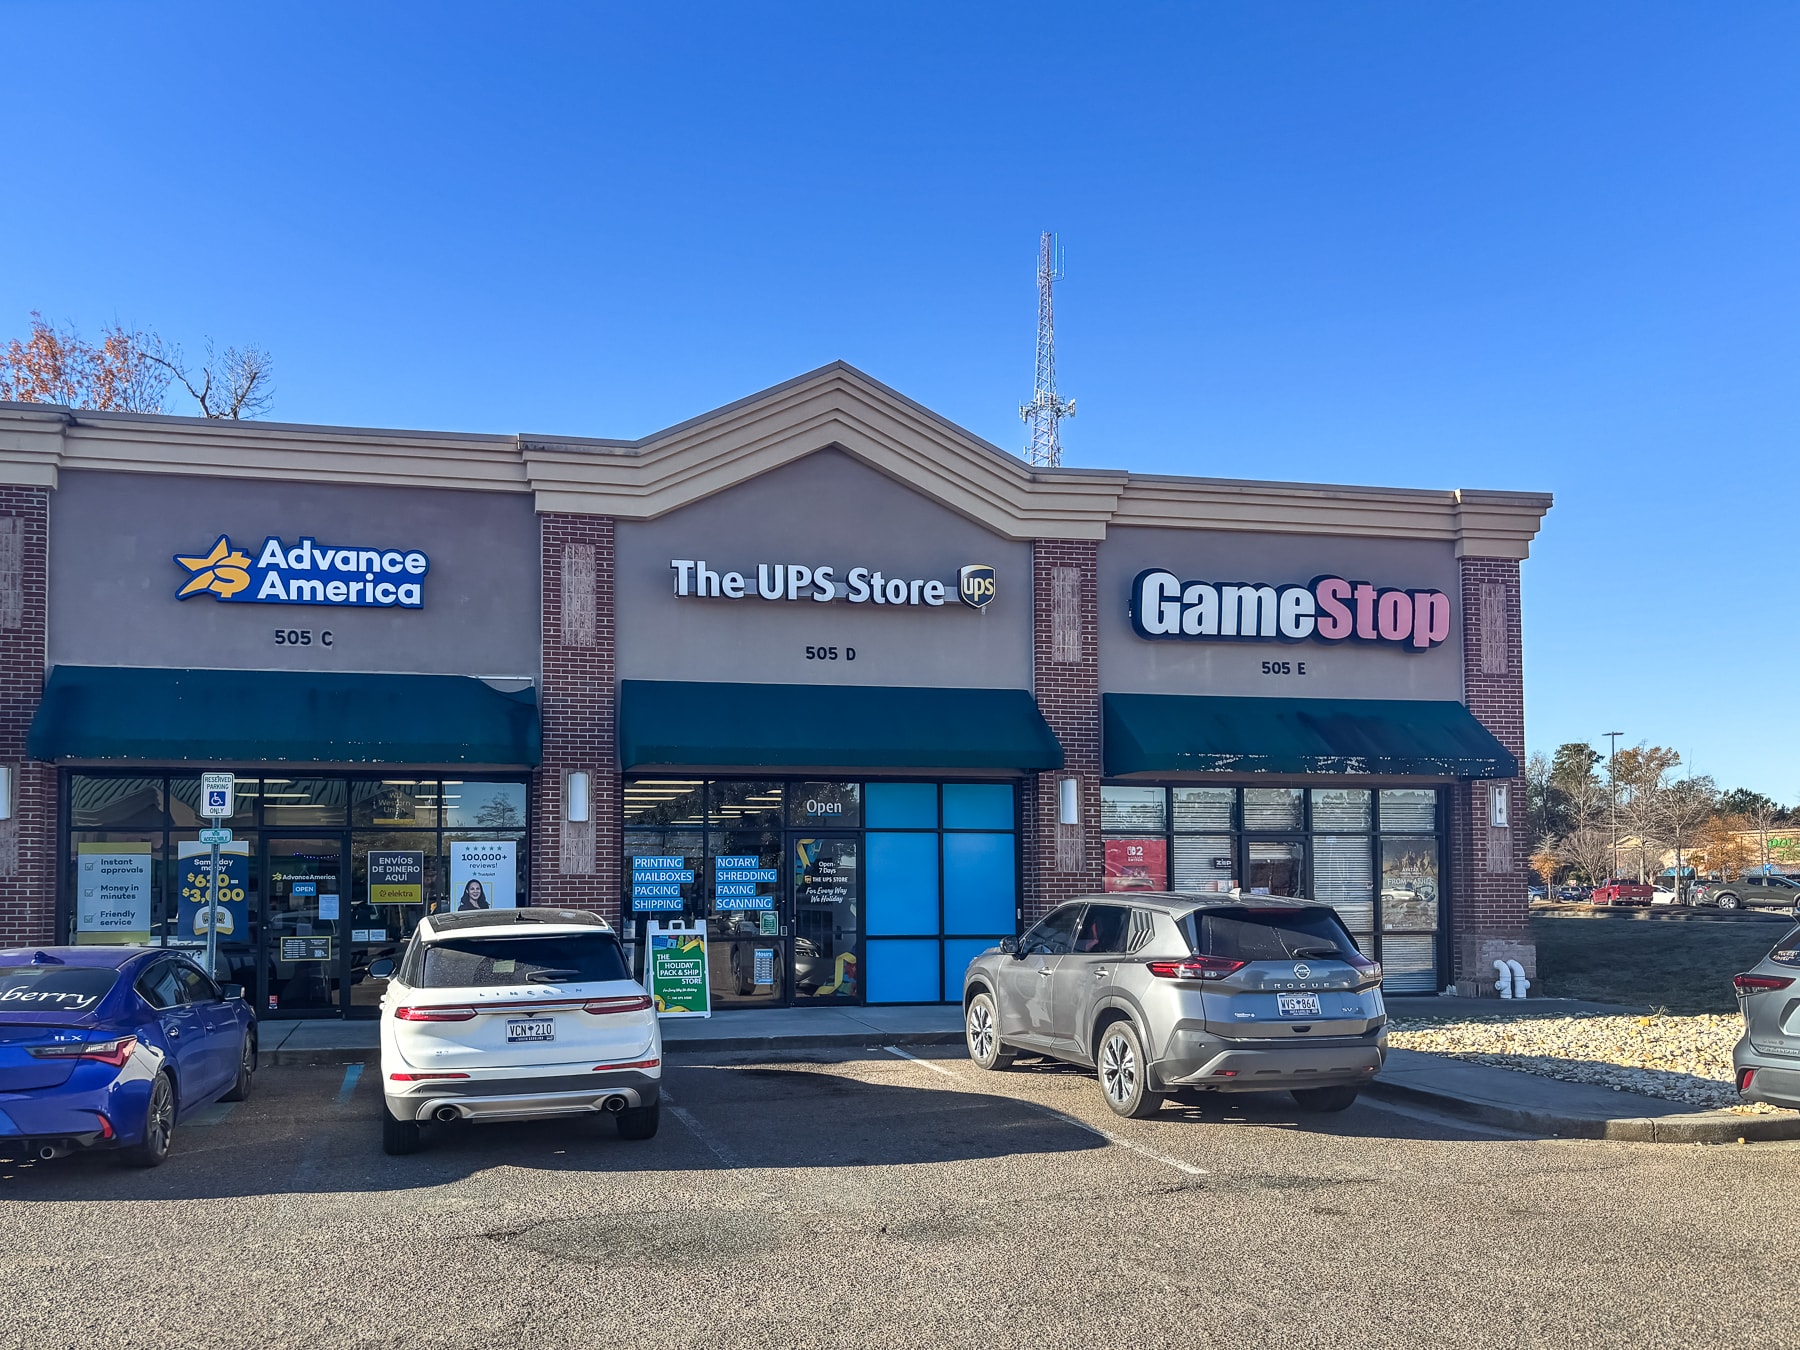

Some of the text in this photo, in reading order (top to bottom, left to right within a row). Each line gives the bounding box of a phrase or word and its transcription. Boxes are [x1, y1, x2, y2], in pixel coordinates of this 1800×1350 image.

[257, 540, 426, 574] Advance
[257, 570, 422, 605] America
[671, 560, 945, 606] The UPS Store
[963, 576, 994, 601] ups
[1140, 571, 1450, 648] GameStop
[274, 629, 333, 646] 505 C
[805, 646, 857, 661] 505 D
[1261, 661, 1306, 676] 505 E
[806, 799, 842, 816] Open
[100, 858, 134, 866] Instant
[379, 855, 414, 865] ENVÍOS
[461, 853, 507, 862] 100,000+
[717, 858, 757, 867] NOTARY
[634, 858, 682, 868] PRINTING
[100, 867, 144, 875] approvals
[201, 865, 227, 873] moey
[372, 865, 420, 873] DE DINERO
[384, 873, 408, 882] AQUÍ
[635, 871, 693, 882] MAILBOXES
[717, 871, 775, 881] SHREDDING
[100, 884, 129, 893] Money
[634, 886, 679, 896] PACKING
[717, 885, 754, 895] FAXING
[387, 890, 414, 898] elektra
[634, 899, 682, 909] SHIPPING
[716, 898, 772, 909] SCANNING
[100, 910, 136, 919] Friendly
[1302, 999, 1316, 1009] 864
[509, 1023, 552, 1037] VCN 210
